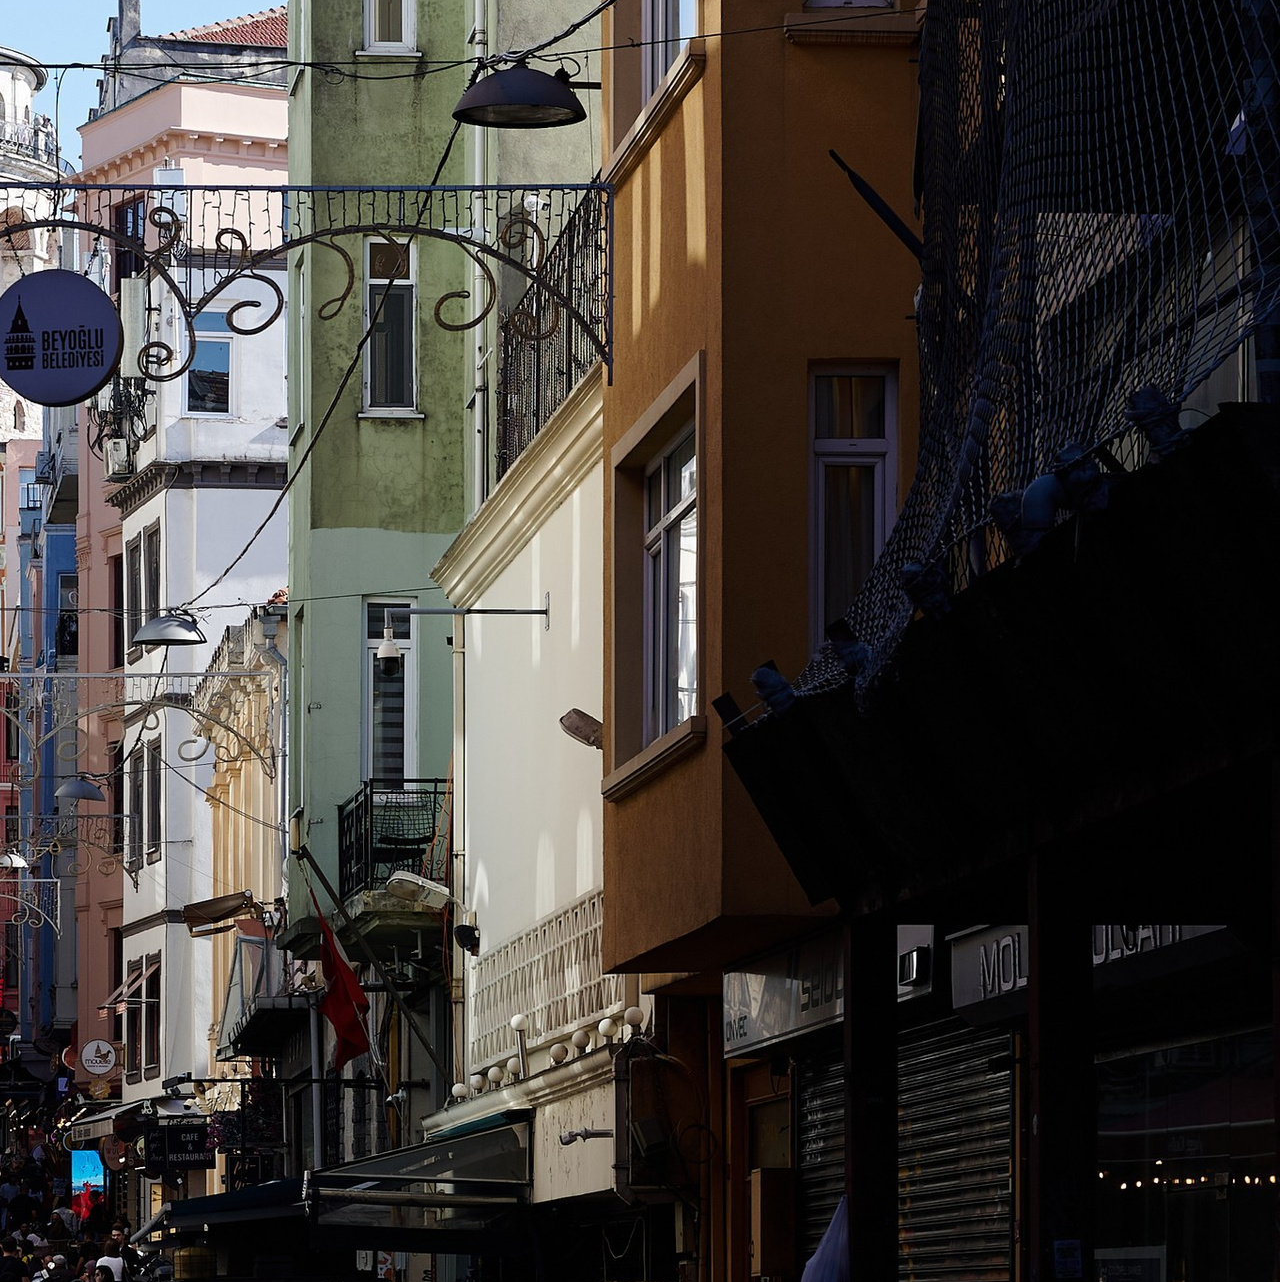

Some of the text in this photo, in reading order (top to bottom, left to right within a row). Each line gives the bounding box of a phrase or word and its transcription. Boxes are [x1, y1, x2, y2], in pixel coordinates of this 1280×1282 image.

[41, 325, 104, 352] BEYOĞLU
[42, 350, 104, 370] BELEDİYESİ
[181, 1133, 199, 1142] CAFE
[187, 1143, 193, 1151] &
